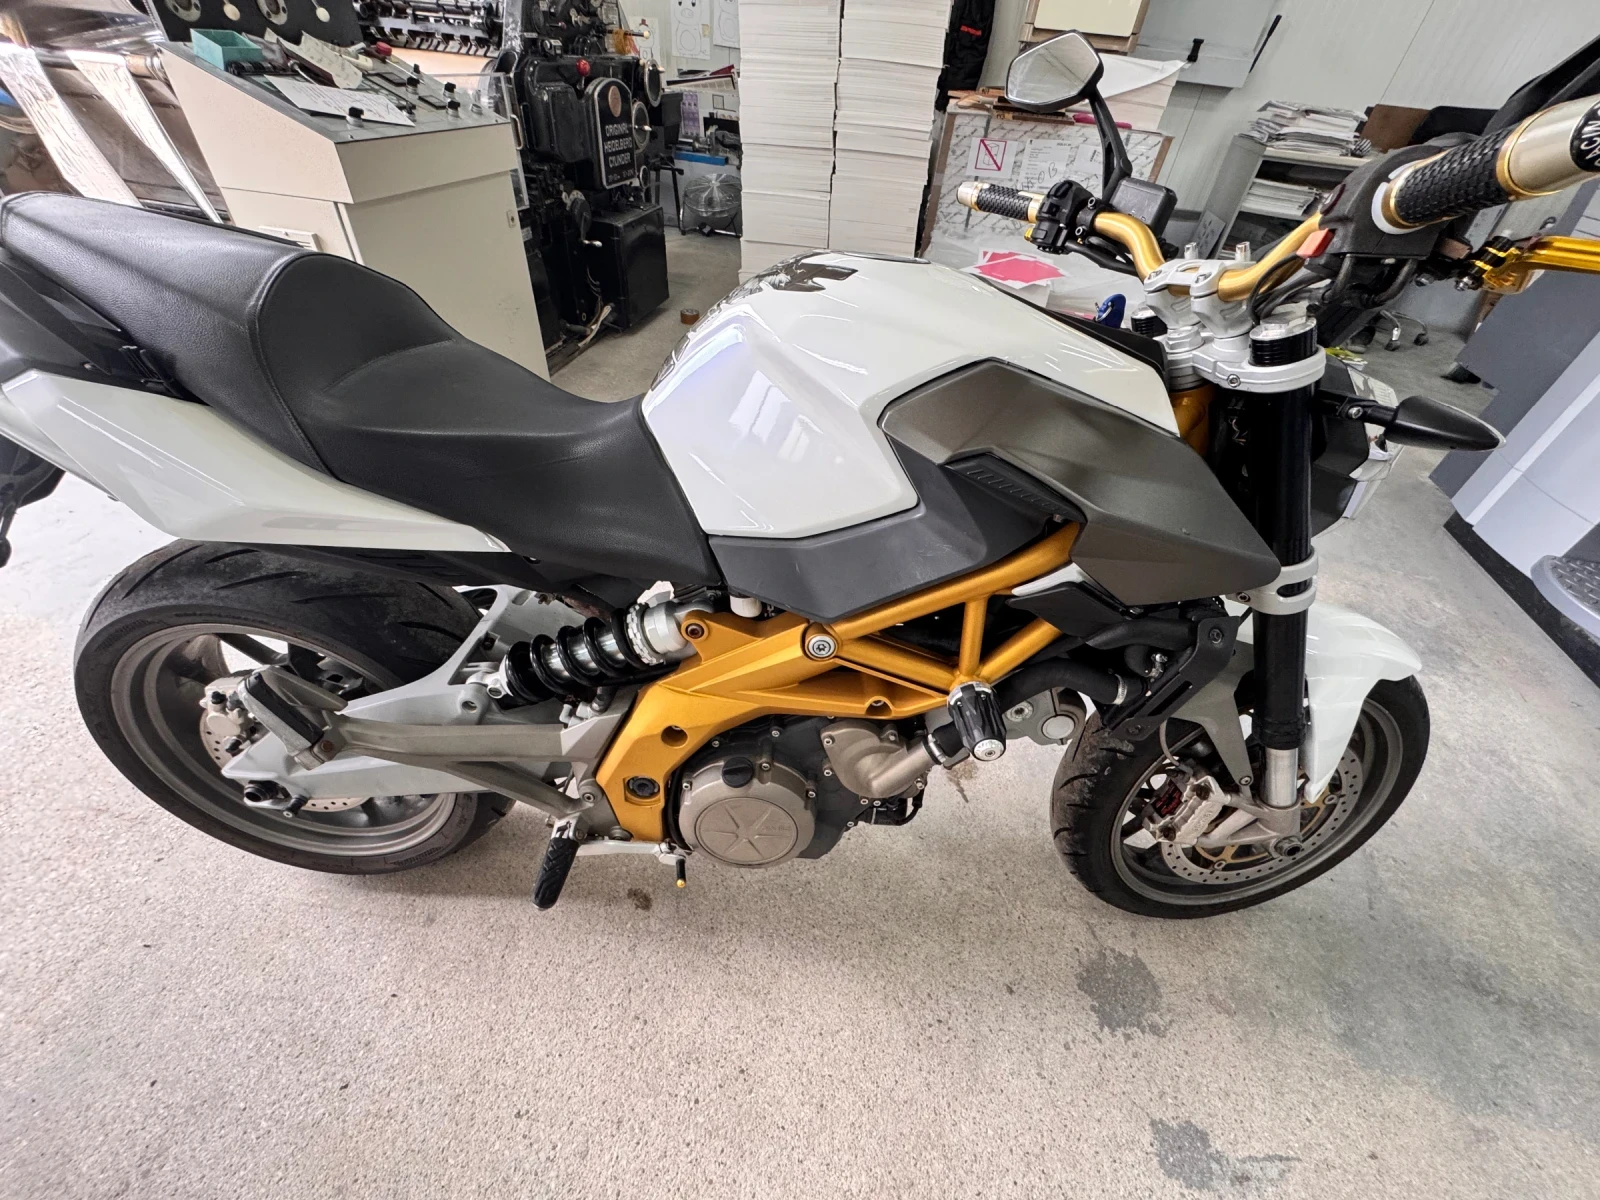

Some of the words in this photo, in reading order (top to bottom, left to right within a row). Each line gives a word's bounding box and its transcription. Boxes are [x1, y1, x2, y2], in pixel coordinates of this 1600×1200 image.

[605, 123, 629, 136] ORIGINAL
[604, 137, 633, 152] HEIDELBERG
[609, 153, 631, 167] CYLINDER
